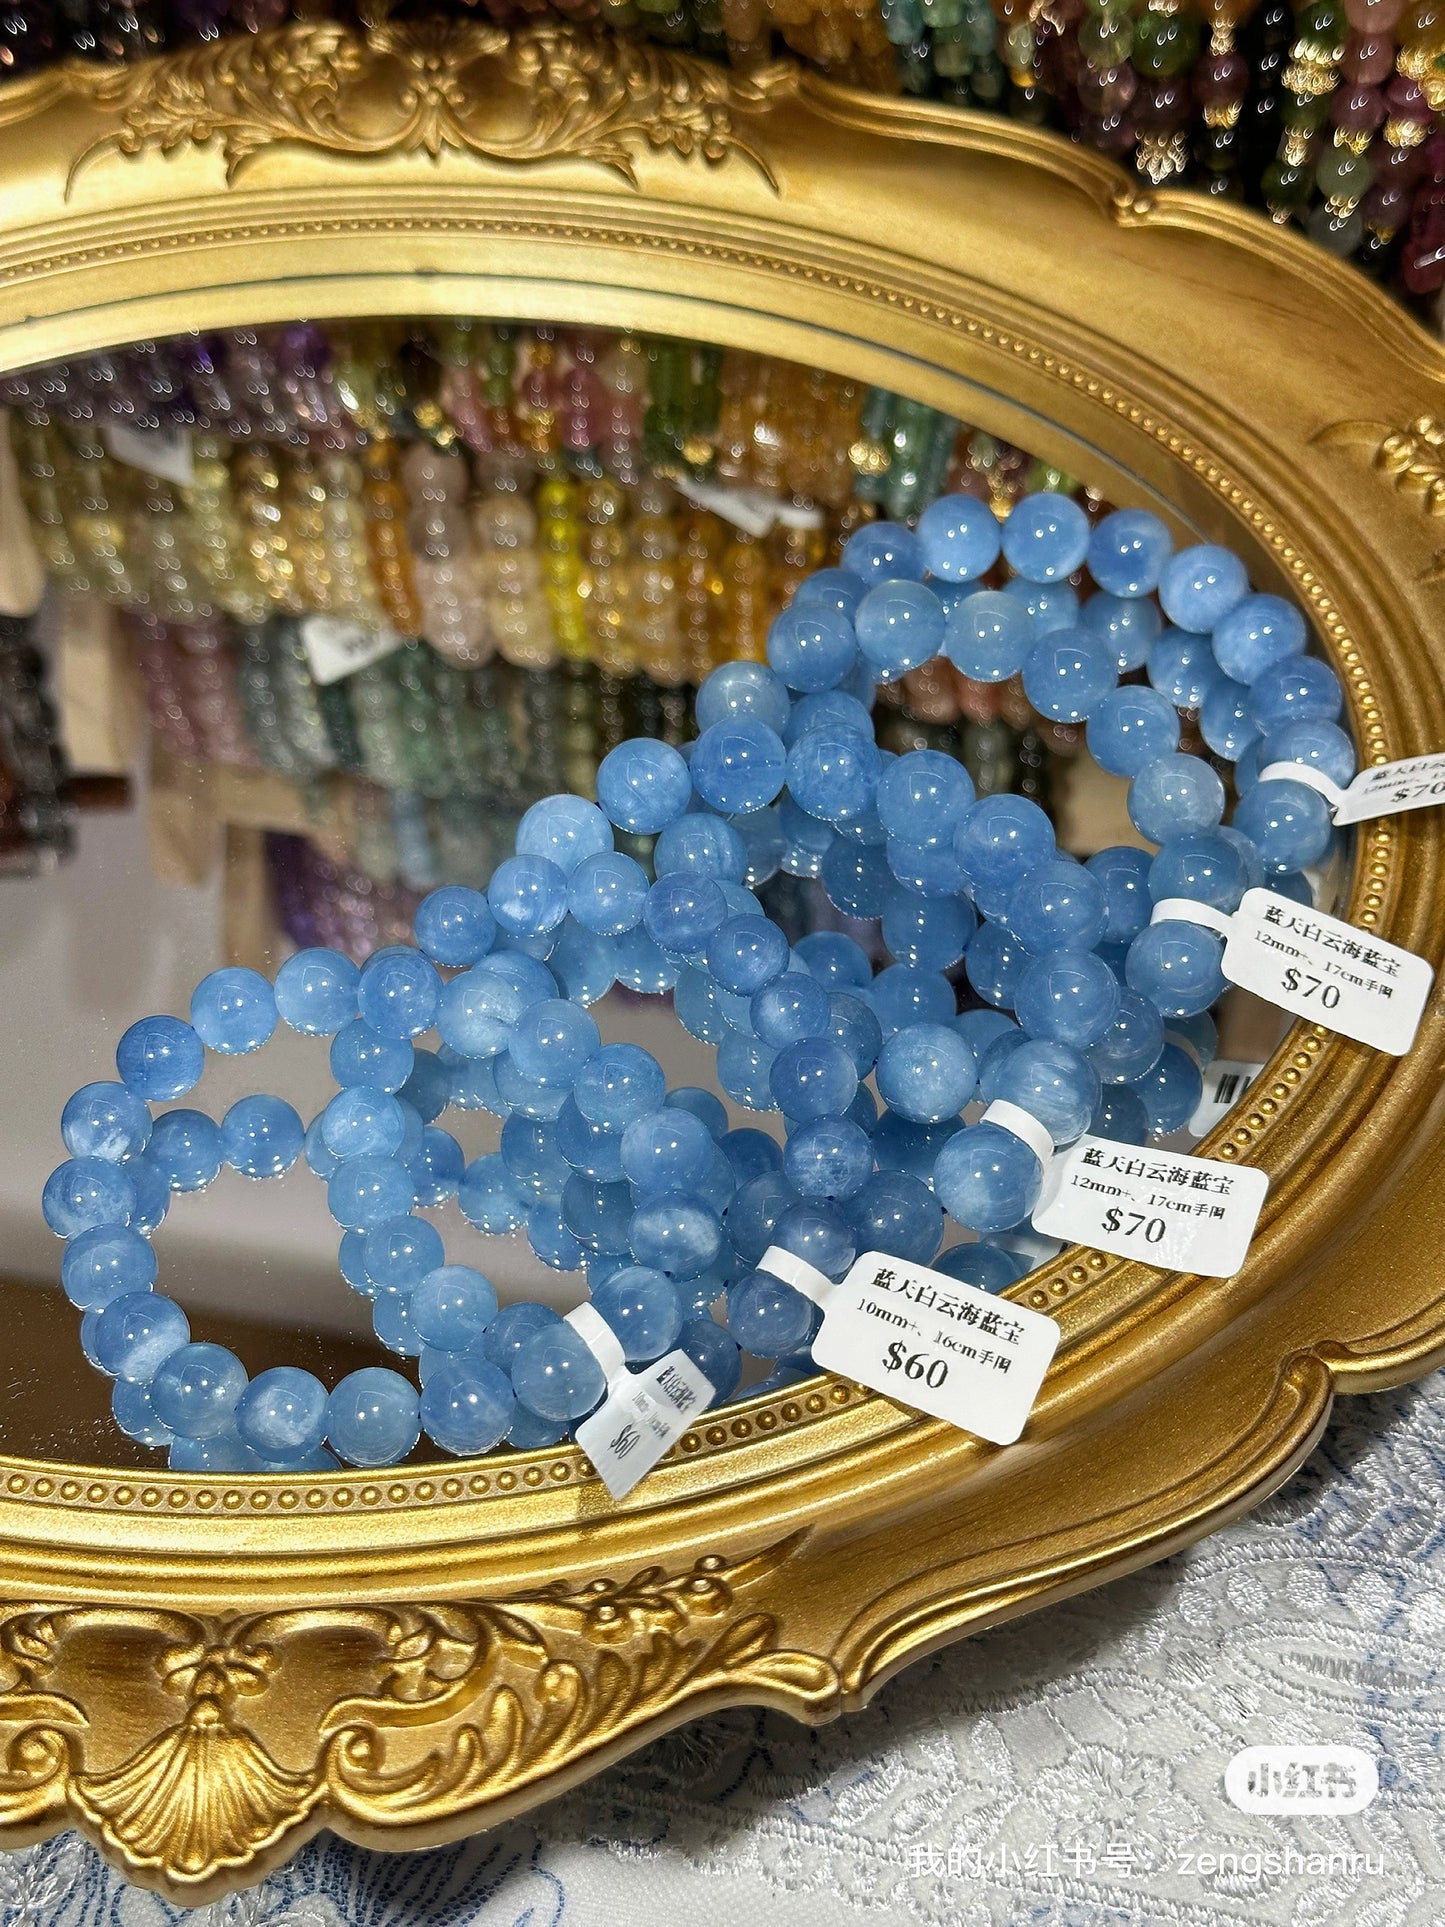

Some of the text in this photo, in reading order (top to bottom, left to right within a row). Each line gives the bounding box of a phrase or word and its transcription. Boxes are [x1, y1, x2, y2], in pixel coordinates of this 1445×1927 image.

[1281, 967, 1341, 1008] $70
[1101, 1206, 1166, 1243] $70
[882, 1340, 948, 1388] $60
[607, 1424, 641, 1460] $60
